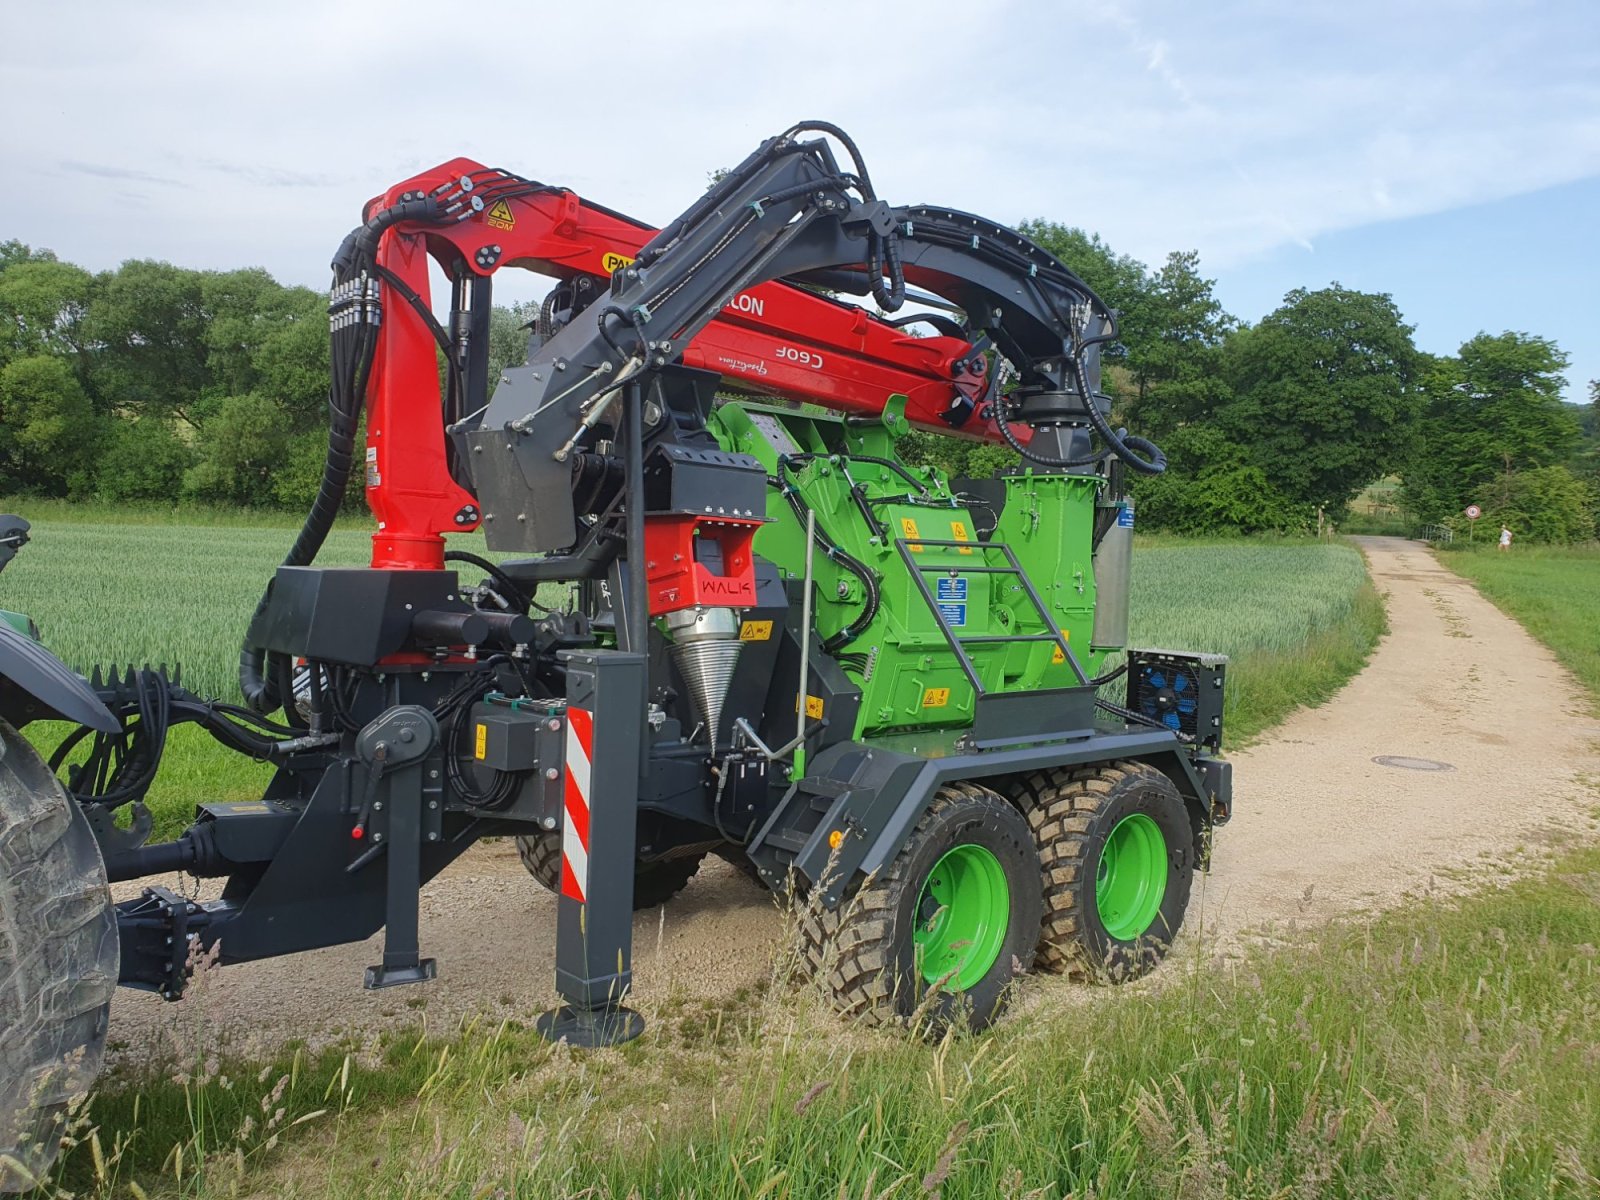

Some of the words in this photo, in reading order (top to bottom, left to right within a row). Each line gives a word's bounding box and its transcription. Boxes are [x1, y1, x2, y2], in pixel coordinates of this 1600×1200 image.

[487, 217, 514, 232] 20M
[726, 294, 764, 316] LON
[775, 346, 823, 369] C60F
